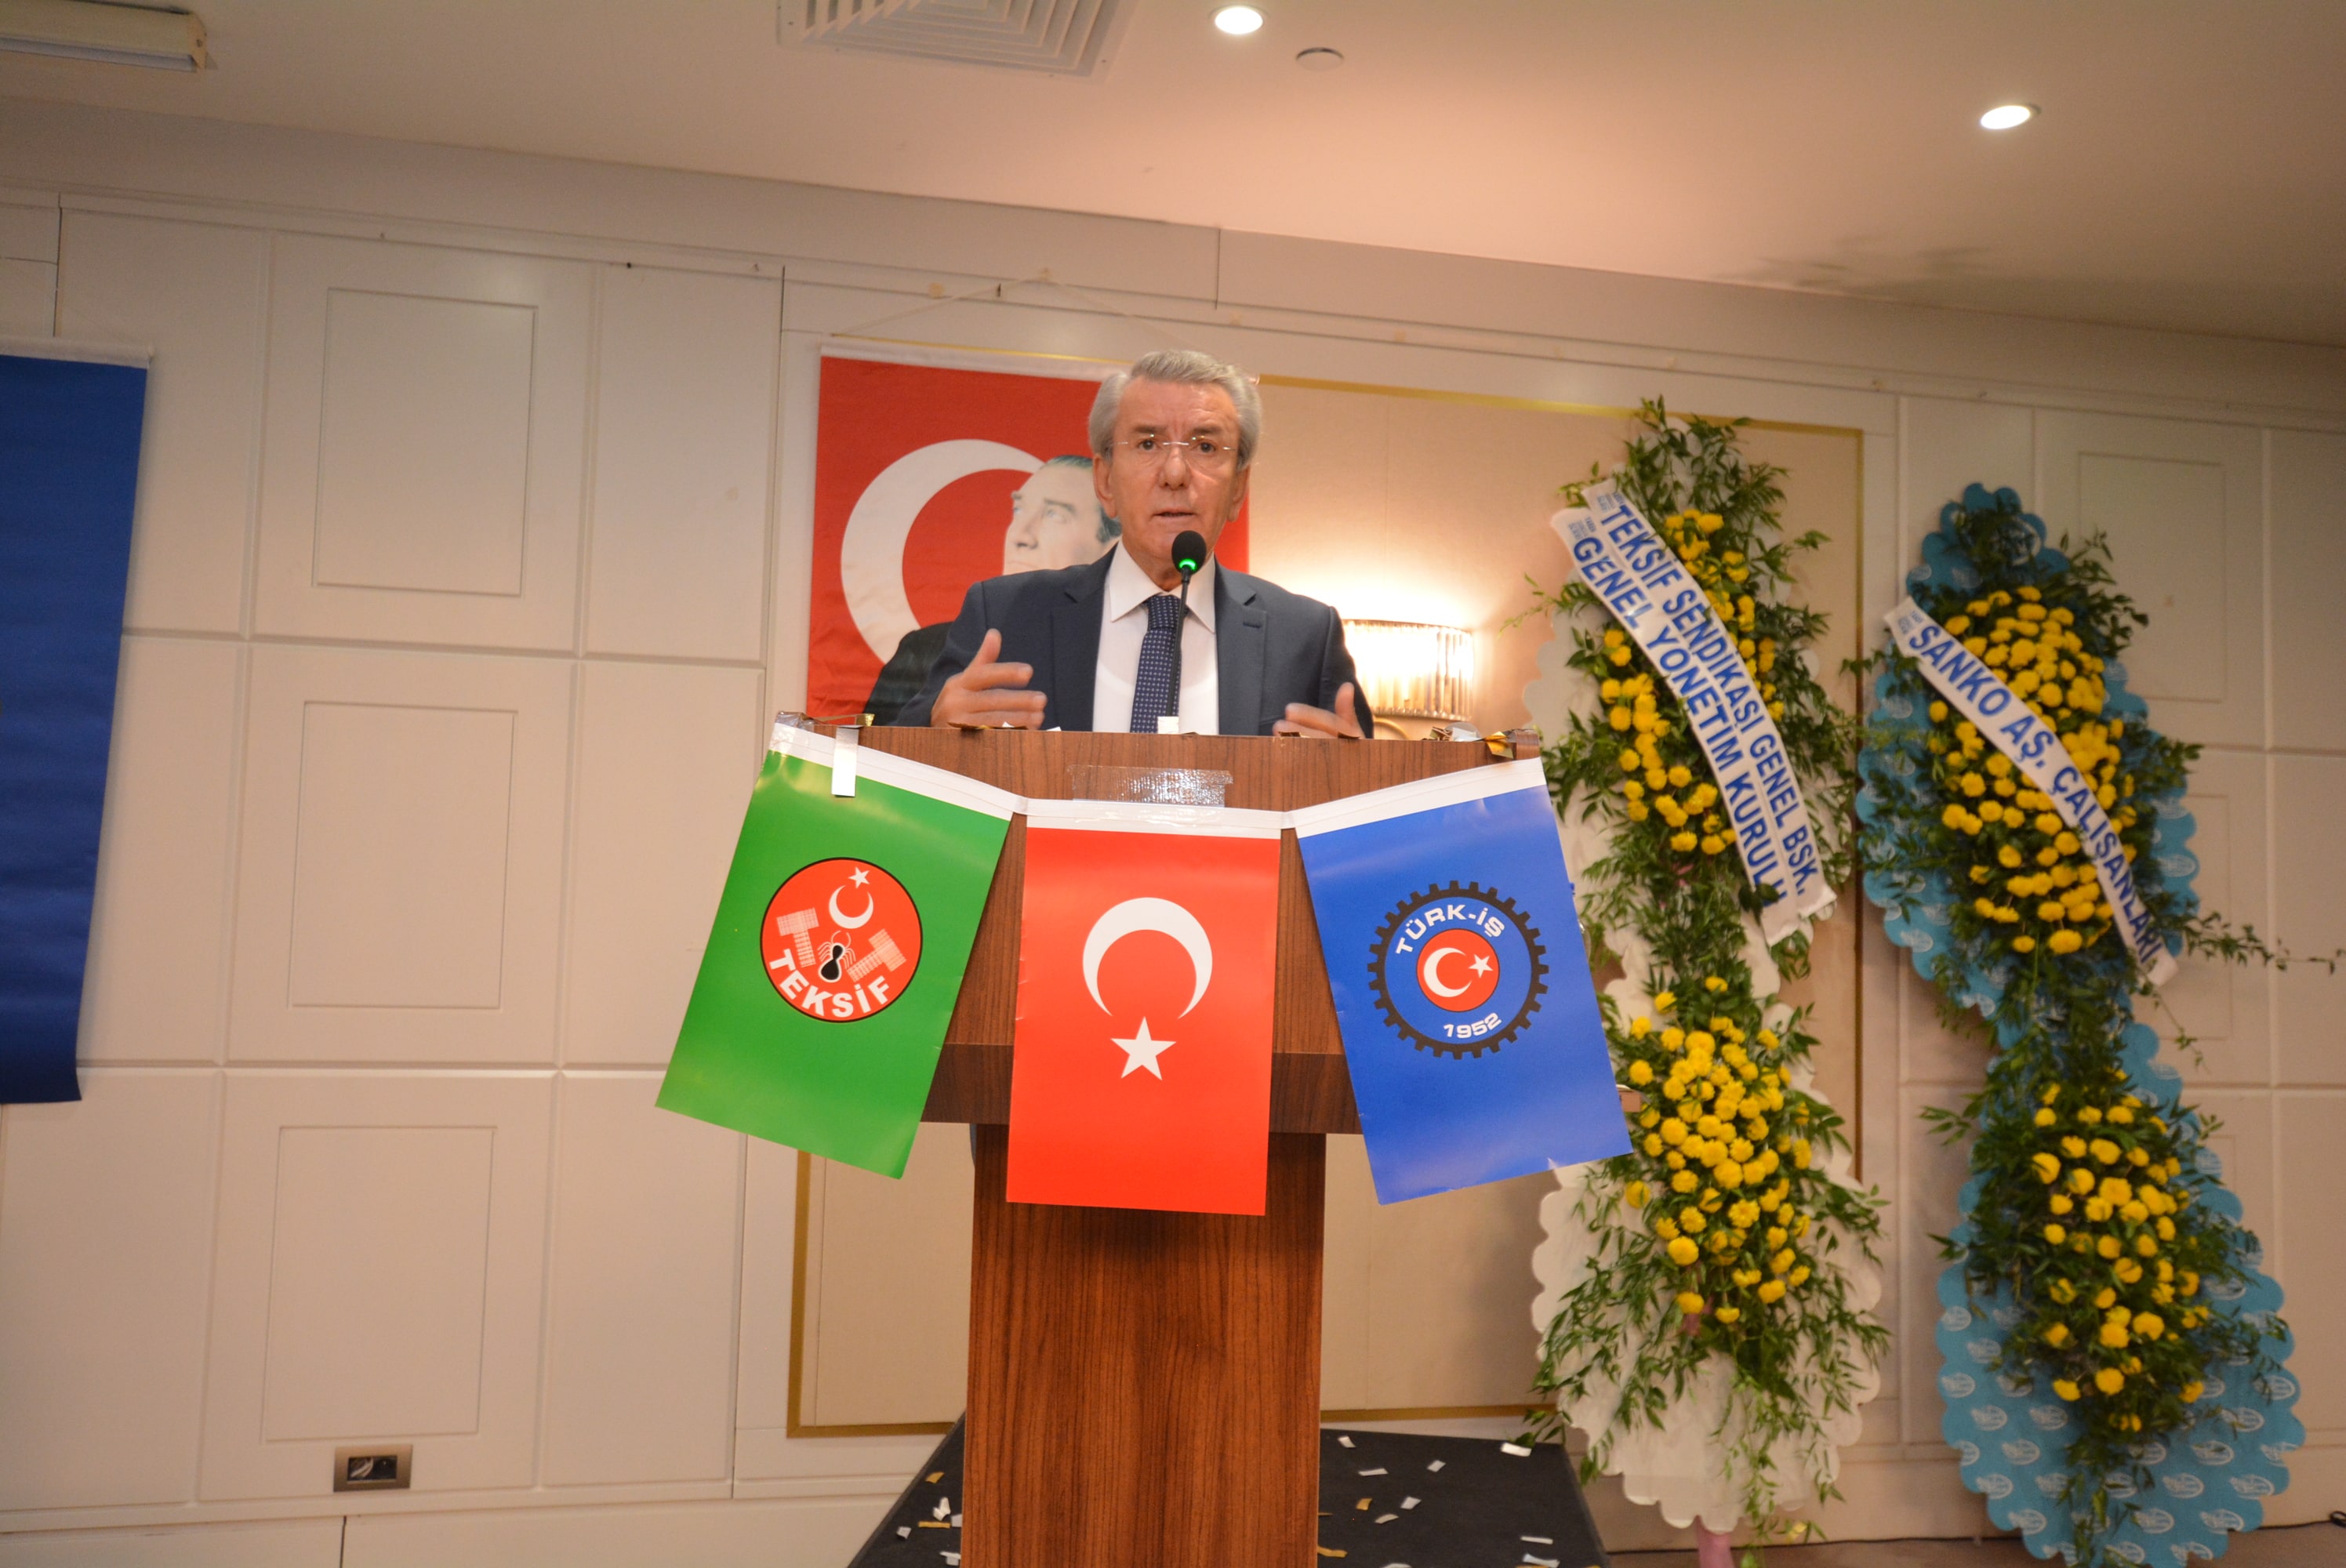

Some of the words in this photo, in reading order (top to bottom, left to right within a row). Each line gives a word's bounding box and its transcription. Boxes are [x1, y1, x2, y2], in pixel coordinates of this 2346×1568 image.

[1574, 537, 1654, 629] GENEL
[1647, 626, 1742, 771] YÖNETİM
[1909, 626, 2011, 717] SANKO
[1601, 504, 1683, 589] TEKSİF
[1662, 589, 1764, 734] SENDİKASI
[1749, 733, 1799, 828] GENEL
[1782, 826, 1818, 895] BSK.
[1396, 905, 1505, 954] TÜRK-İŞ
[769, 949, 889, 1018] TEKSİF
[1444, 1013, 1502, 1038] 1952
